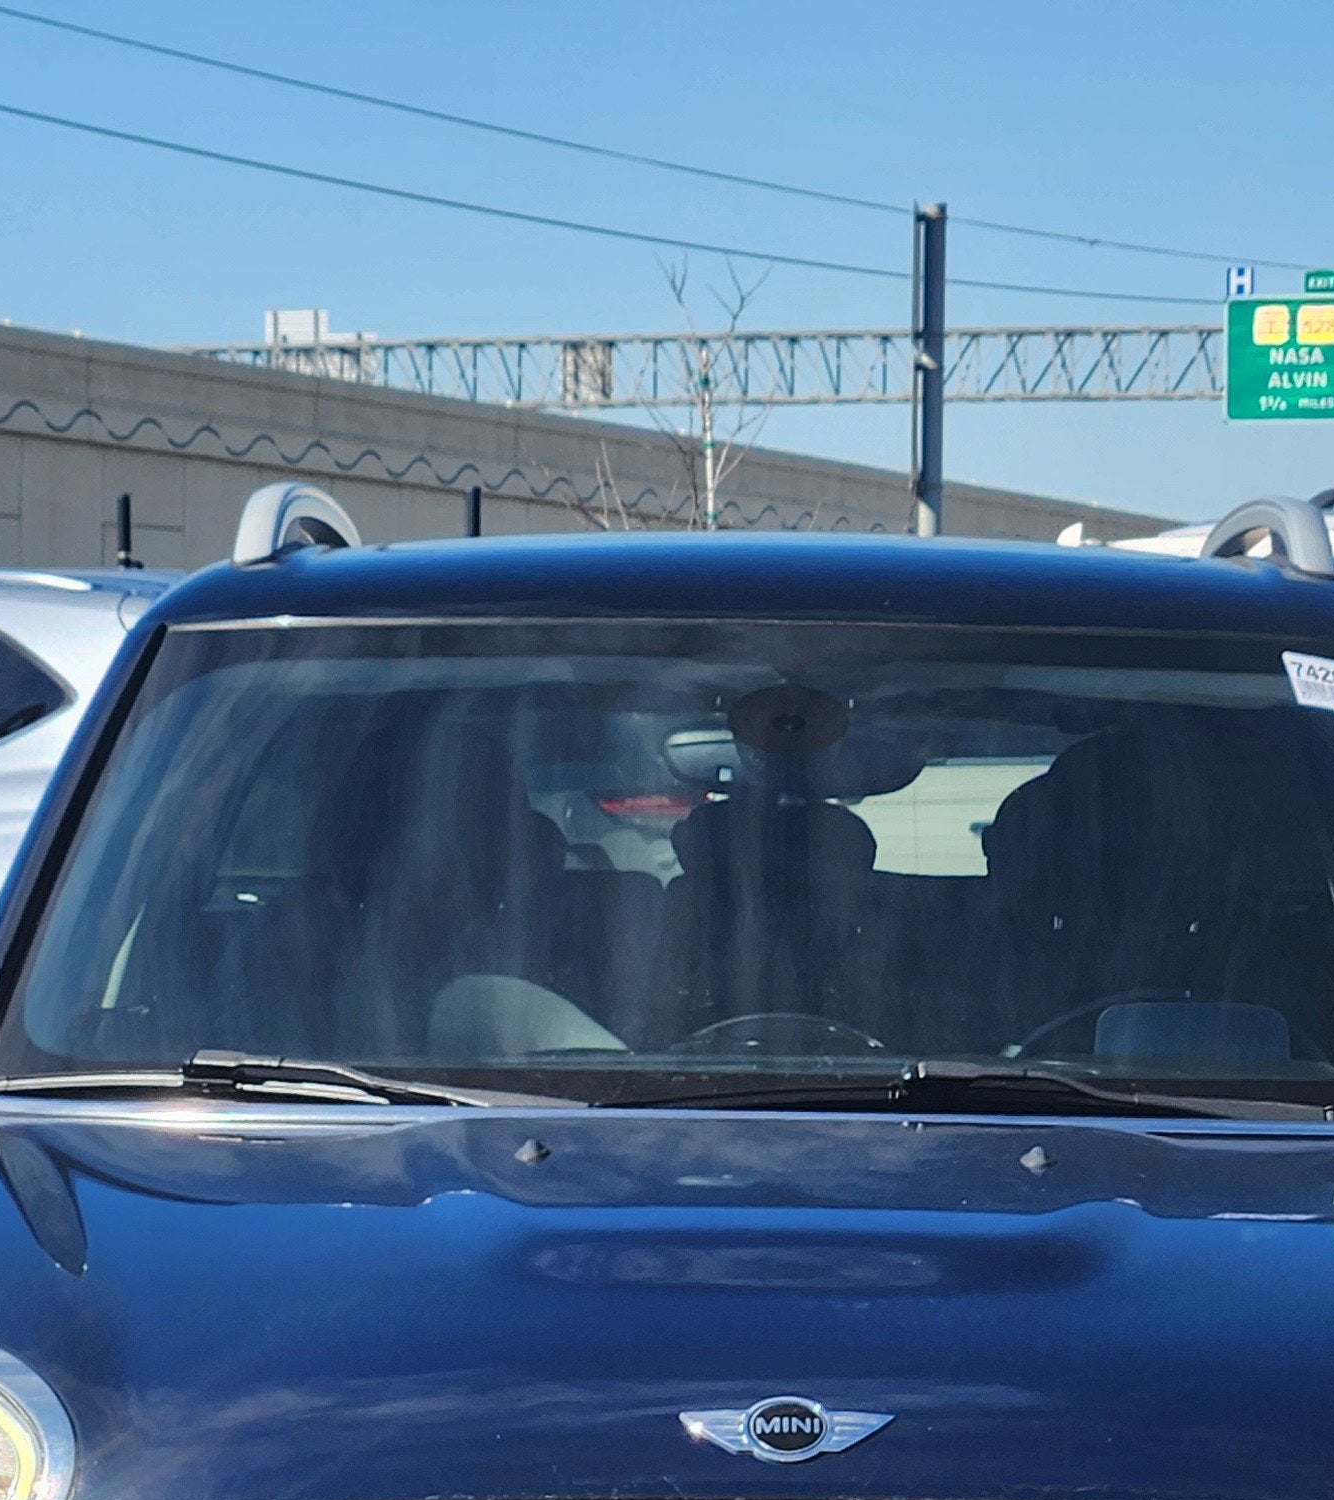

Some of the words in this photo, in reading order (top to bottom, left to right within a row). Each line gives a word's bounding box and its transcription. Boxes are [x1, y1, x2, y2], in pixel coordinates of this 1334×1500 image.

[1307, 276, 1334, 289] EXIT
[1269, 347, 1324, 365] NASA
[1268, 371, 1327, 389] ALVIN
[755, 1416, 821, 1435] MINI
